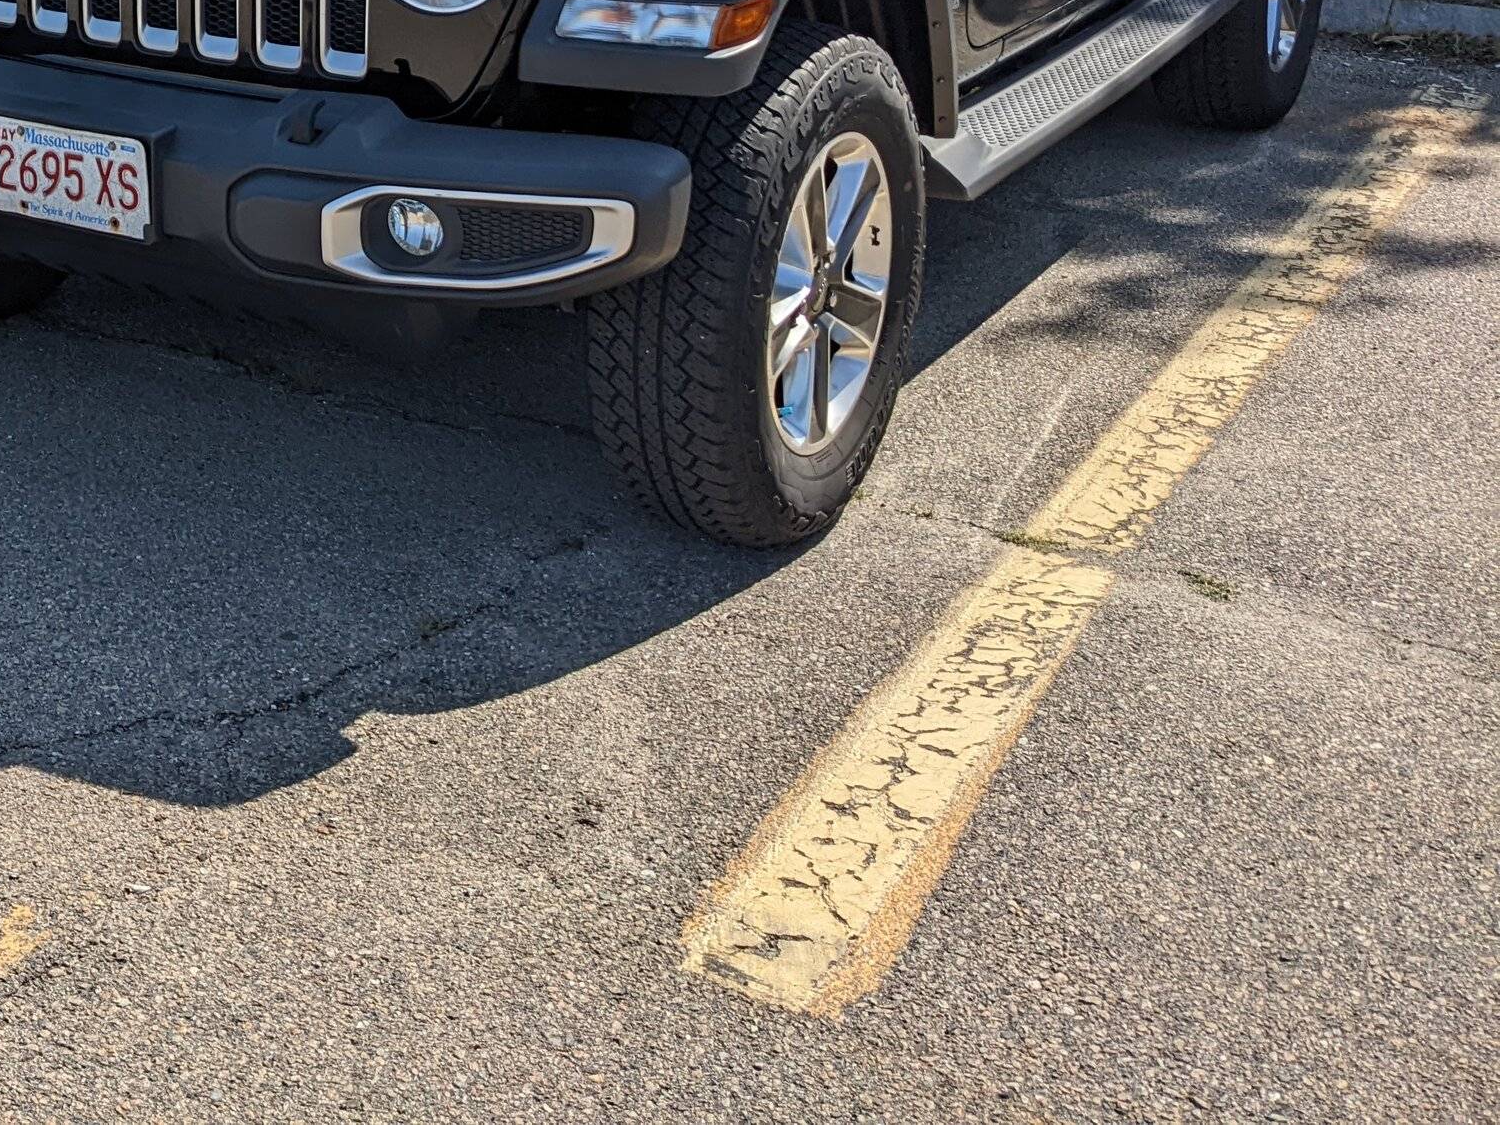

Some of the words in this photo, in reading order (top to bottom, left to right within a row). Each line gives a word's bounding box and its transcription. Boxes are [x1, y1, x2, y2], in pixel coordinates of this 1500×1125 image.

[24, 127, 111, 158] Massachusetts
[95, 157, 139, 211] XS
[28, 202, 40, 212] The
[42, 204, 63, 217] Spirit
[65, 209, 73, 220] of
[75, 211, 110, 226] America
